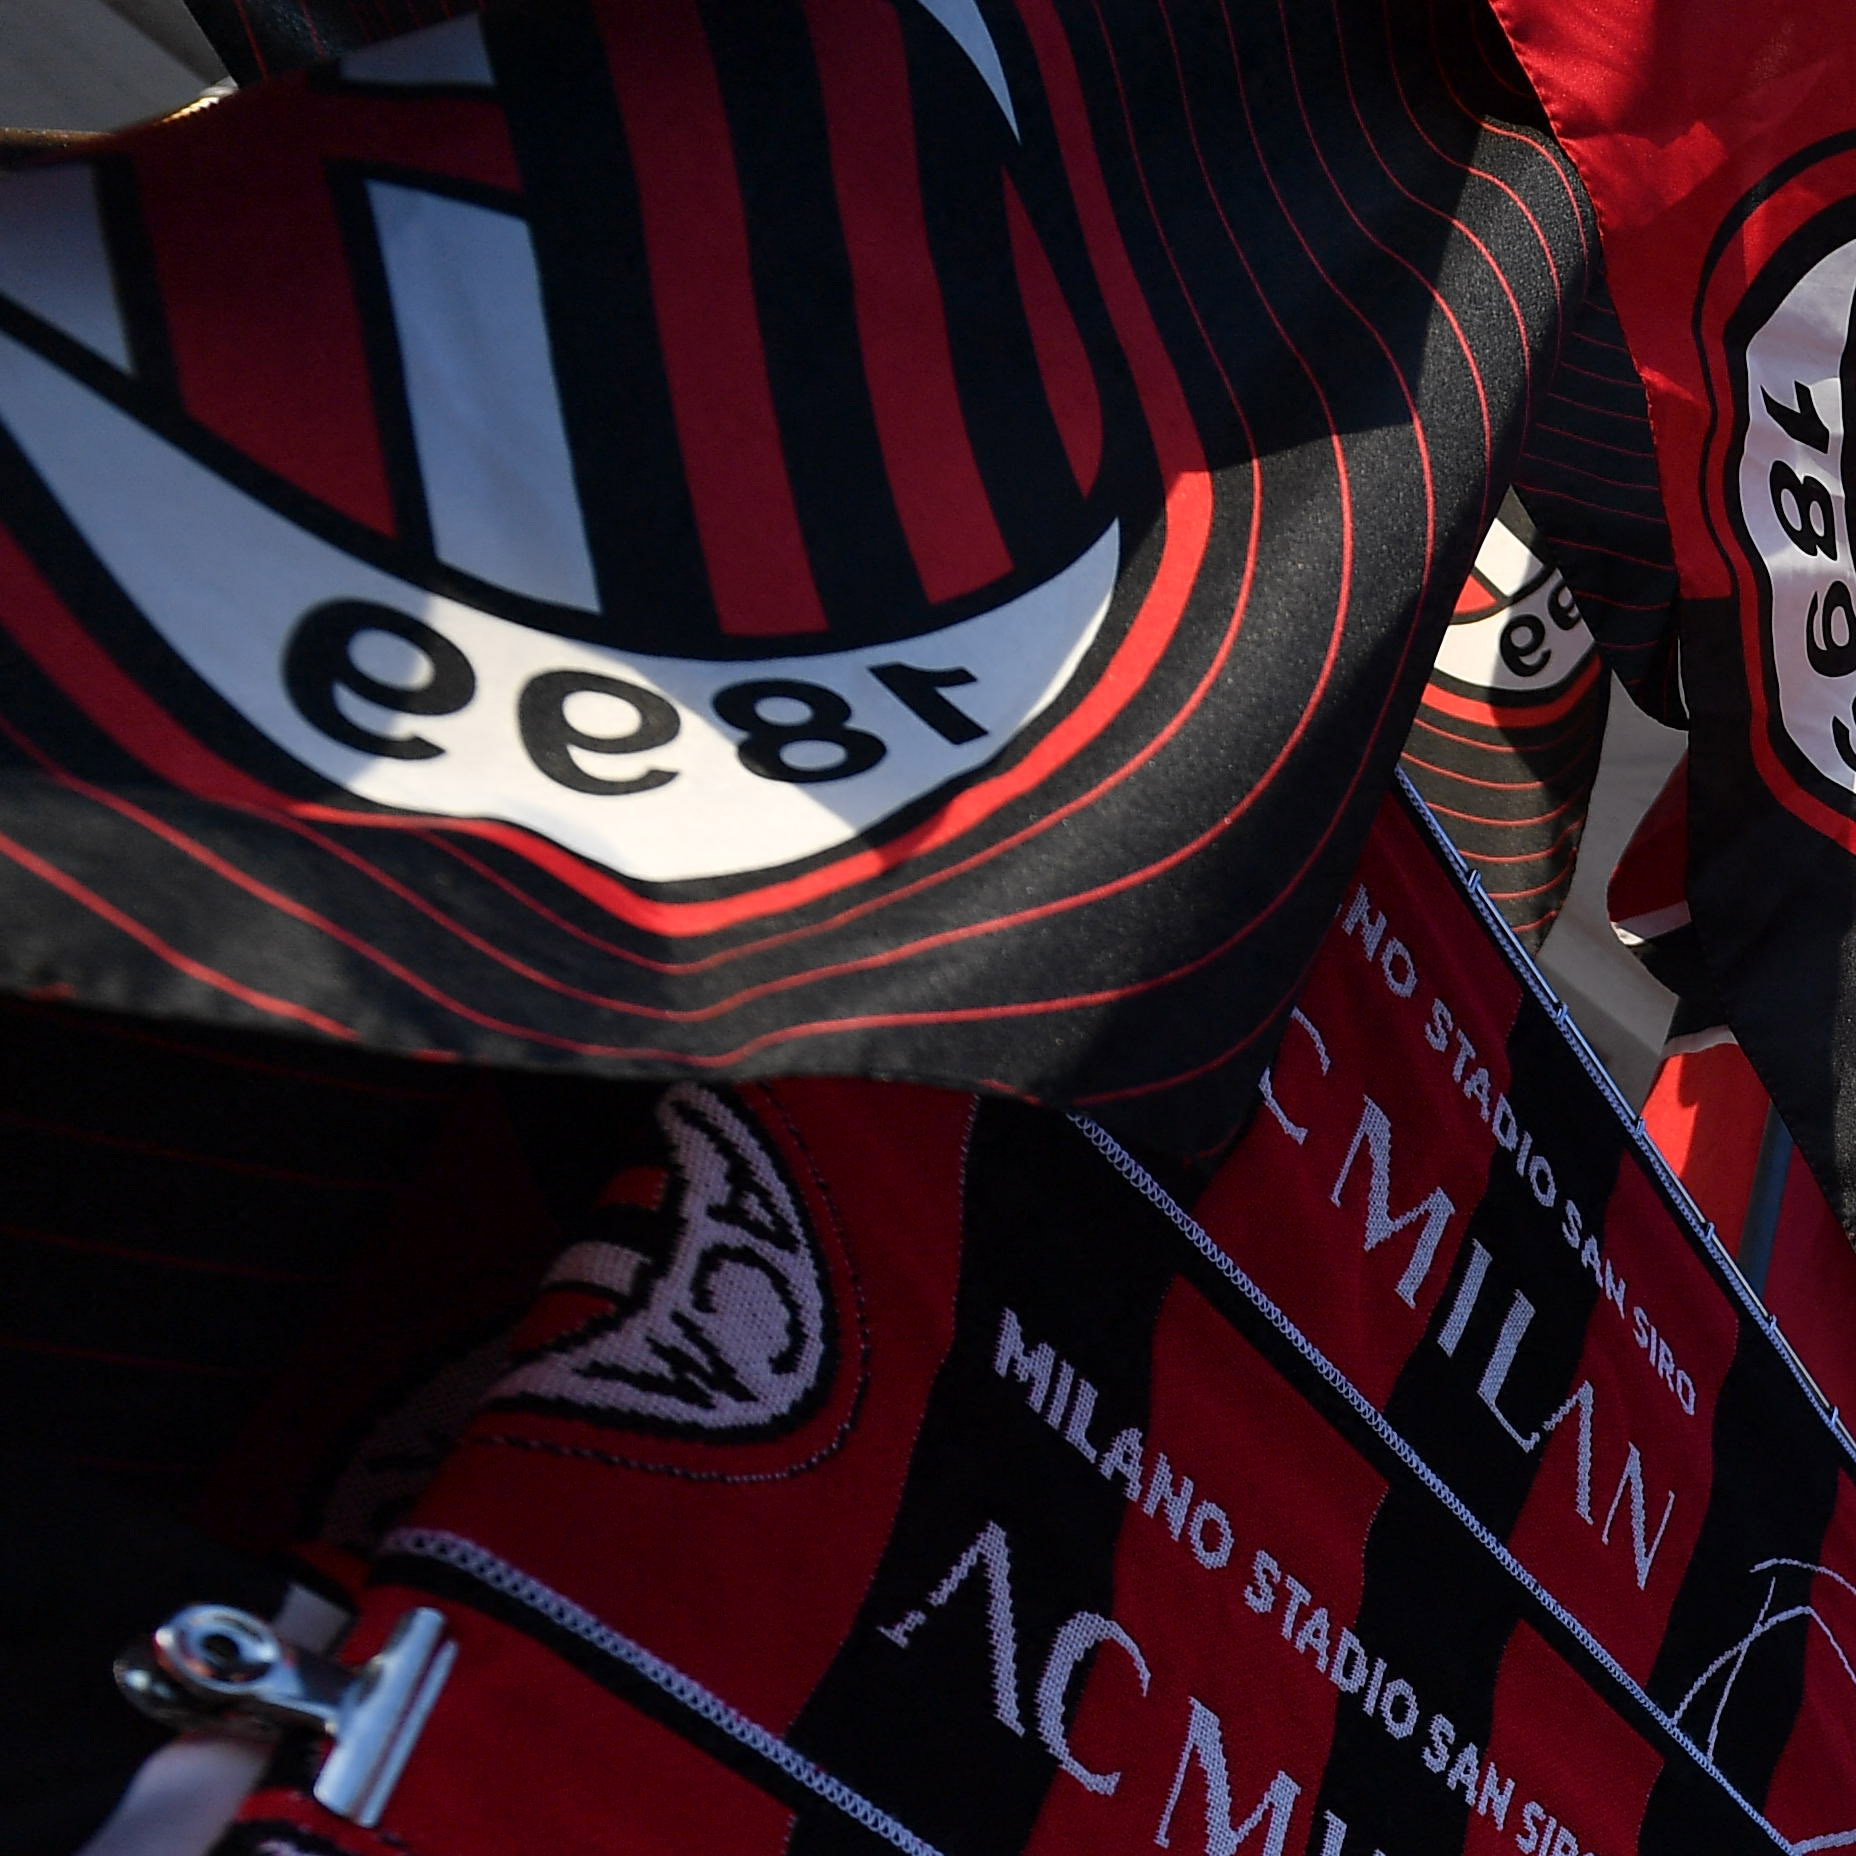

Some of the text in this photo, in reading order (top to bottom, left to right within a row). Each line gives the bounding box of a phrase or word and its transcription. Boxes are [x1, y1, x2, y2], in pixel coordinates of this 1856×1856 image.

[1331, 1095, 1675, 1590] MILAN
[1425, 999, 1696, 1415] STADIO SAN SIRO
[880, 1521, 1151, 1796] AC
[995, 1308, 1234, 1569] MILANO
[1245, 1550, 1419, 1739] STADIO
[1422, 1714, 1515, 1831] SAN
